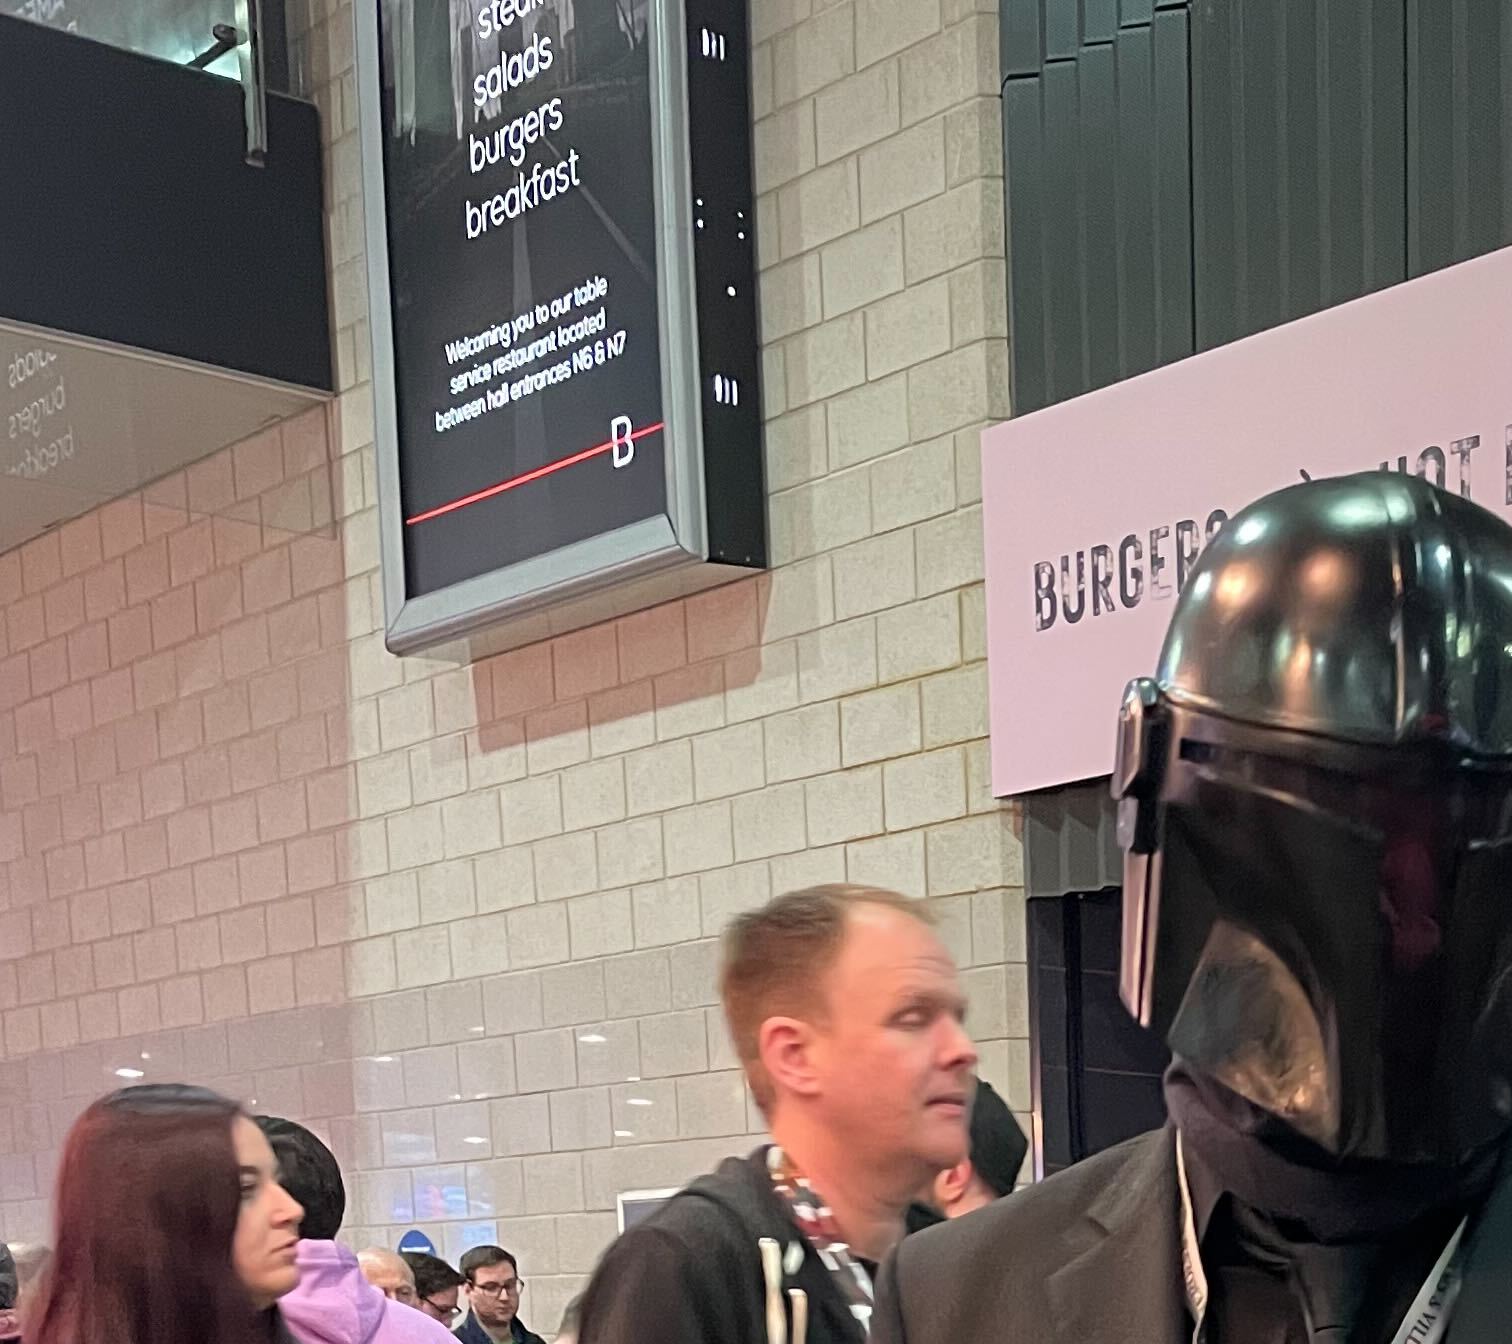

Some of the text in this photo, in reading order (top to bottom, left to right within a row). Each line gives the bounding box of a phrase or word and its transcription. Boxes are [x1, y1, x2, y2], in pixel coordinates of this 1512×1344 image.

[478, 0, 544, 39] stea
[473, 33, 554, 107] salads
[469, 97, 563, 173] burgers
[466, 148, 580, 239] breakfast
[445, 276, 608, 364] Welcoming you to our table
[450, 306, 606, 395] service restaurant located
[435, 330, 627, 432] between hall entrances N6 & N7
[611, 415, 634, 468] B
[1379, 435, 1480, 500] OT
